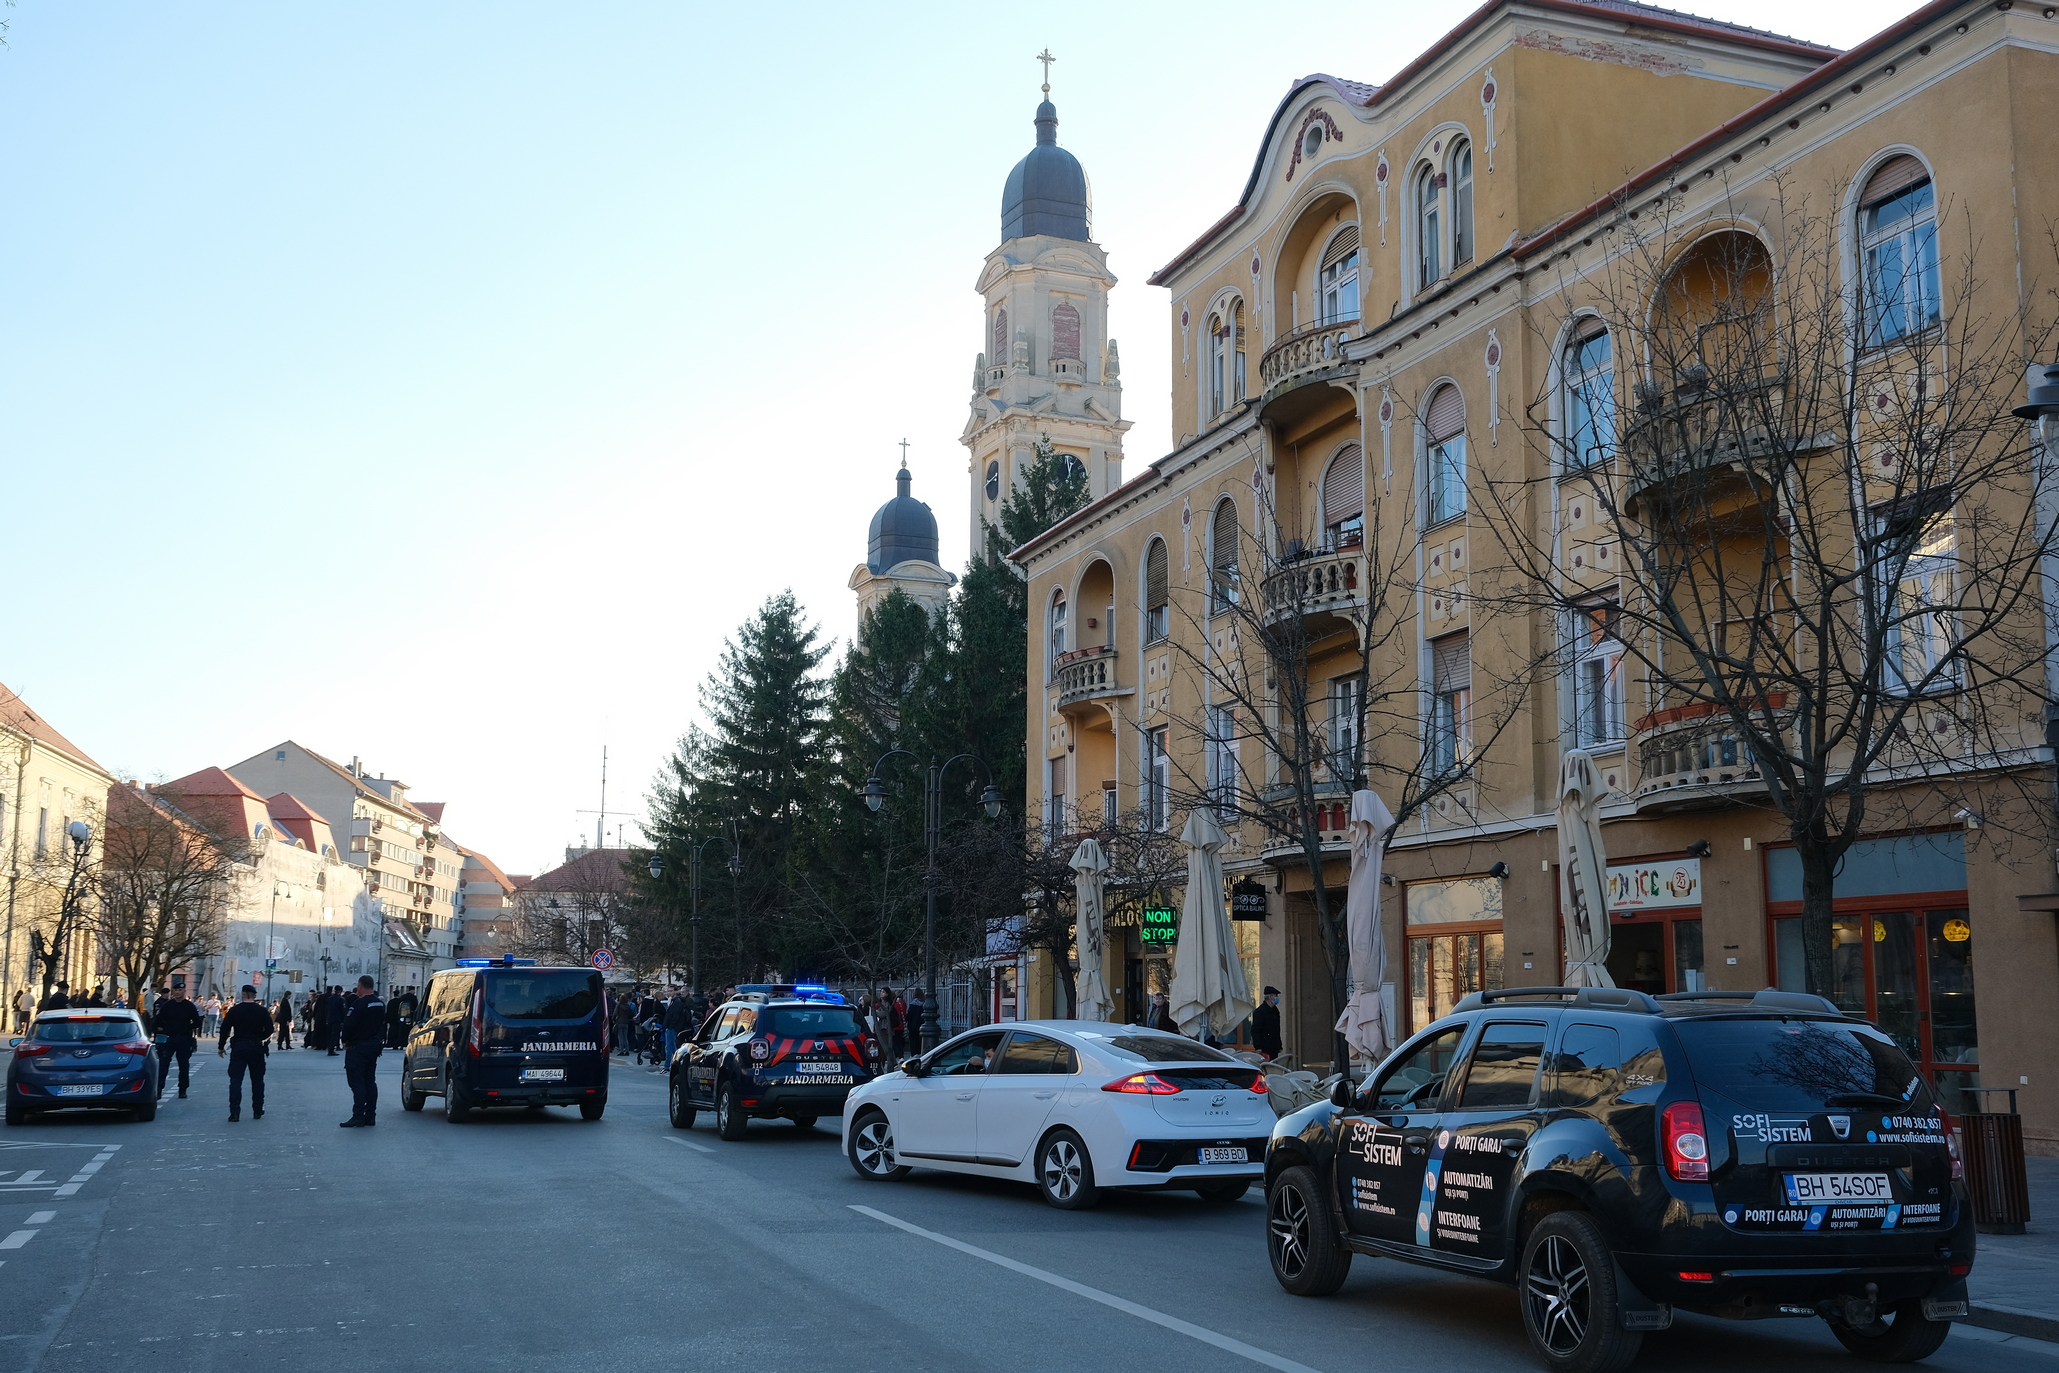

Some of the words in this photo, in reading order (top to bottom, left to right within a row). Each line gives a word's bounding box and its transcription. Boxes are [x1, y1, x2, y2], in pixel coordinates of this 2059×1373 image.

[1146, 911, 1171, 922] NON
[1142, 928, 1174, 940] STOP
[520, 1042, 597, 1052] JANDARMERIA
[526, 1070, 538, 1078] MAI
[801, 1064, 815, 1072] MAI
[816, 1064, 838, 1072] 54848
[784, 1076, 854, 1084] JANDARMERIA
[63, 1086, 73, 1094] BH
[1733, 1114, 1770, 1128] SOFI
[1892, 1116, 1912, 1128] 0740
[1913, 1117, 1928, 1128] 382
[1927, 1118, 1942, 1130] 857
[1352, 1122, 1378, 1142] SOFI
[1758, 1128, 1812, 1142] SISTEM
[1879, 1132, 1946, 1144] www.sofisistem.ro
[1478, 1137, 1502, 1154] GARAJ
[1204, 1150, 1212, 1160] B
[1214, 1150, 1228, 1160] 969
[1231, 1149, 1246, 1160] BDI
[1364, 1142, 1402, 1166] SISTEM
[1797, 1158, 1889, 1166] DUSTER
[1444, 1170, 1493, 1190] AUTOMATIZĂRI
[1797, 1178, 1825, 1197] BH
[1830, 1176, 1886, 1196] 54SOF
[1788, 1189, 1797, 1198] RO
[1358, 1202, 1396, 1215] www.sofisistem.ro
[1832, 1206, 1886, 1218] AUTOMATIZĂRI
[1904, 1204, 1940, 1215] INTERFOANE
[1438, 1210, 1481, 1230] INTERFOANE
[1777, 1210, 1808, 1222] GARAJ
